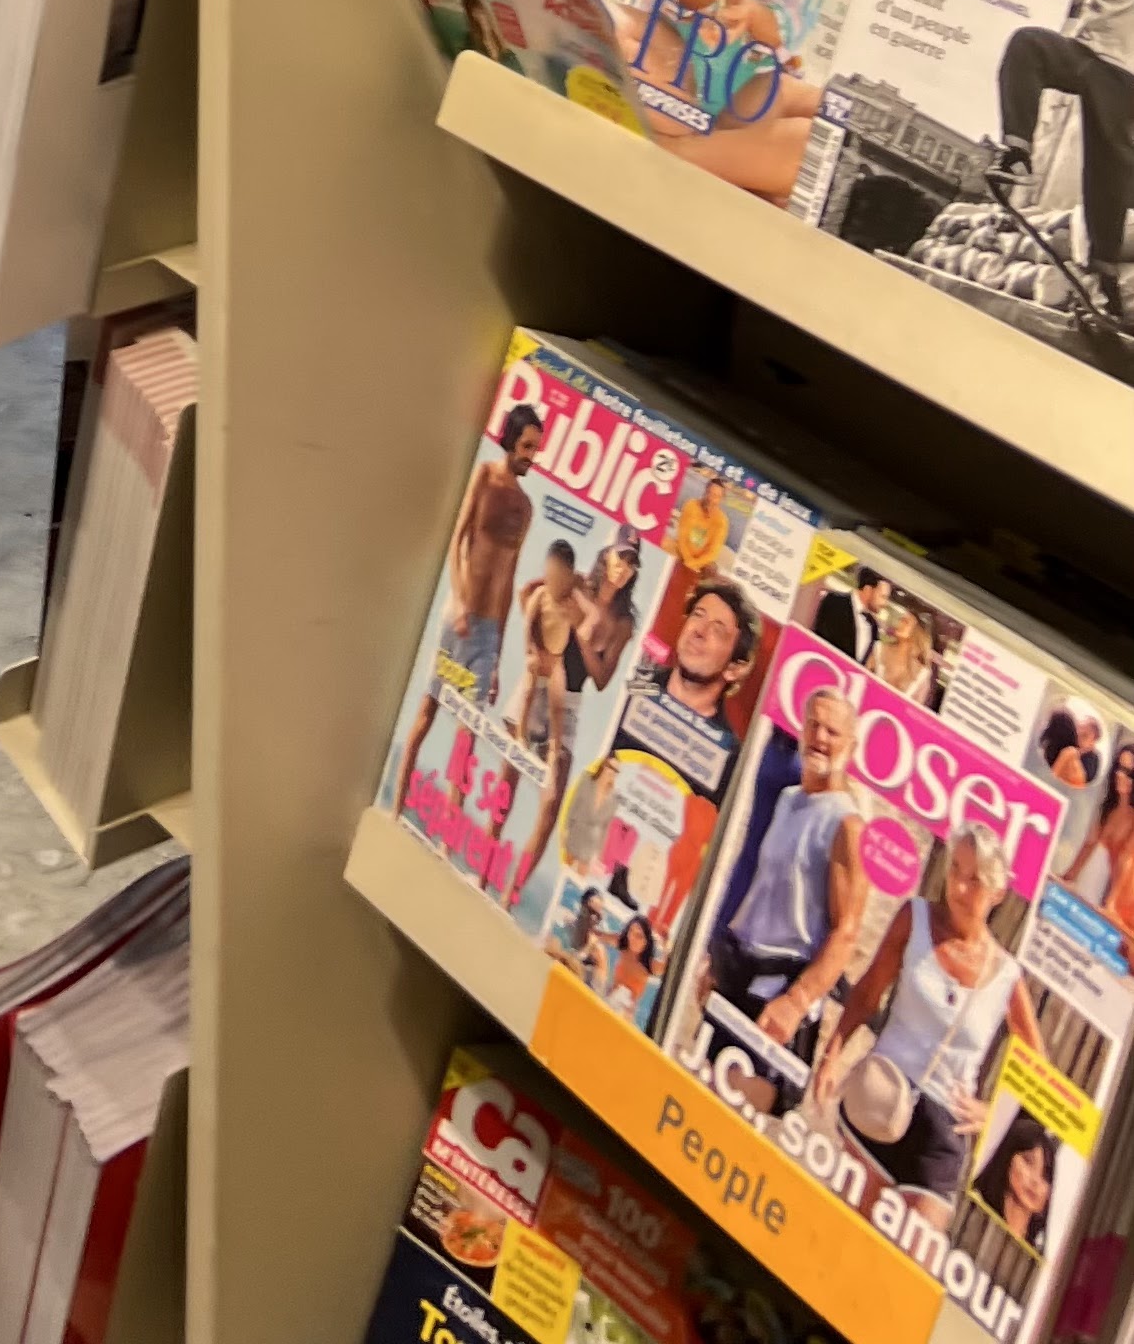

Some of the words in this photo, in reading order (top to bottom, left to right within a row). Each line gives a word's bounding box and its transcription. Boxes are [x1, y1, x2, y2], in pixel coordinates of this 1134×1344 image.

[486, 359, 674, 532] Public
[657, 1093, 789, 1237] People
[777, 1112, 866, 1207] son
[871, 1187, 1024, 1339] amour
[419, 1297, 464, 1344] To
